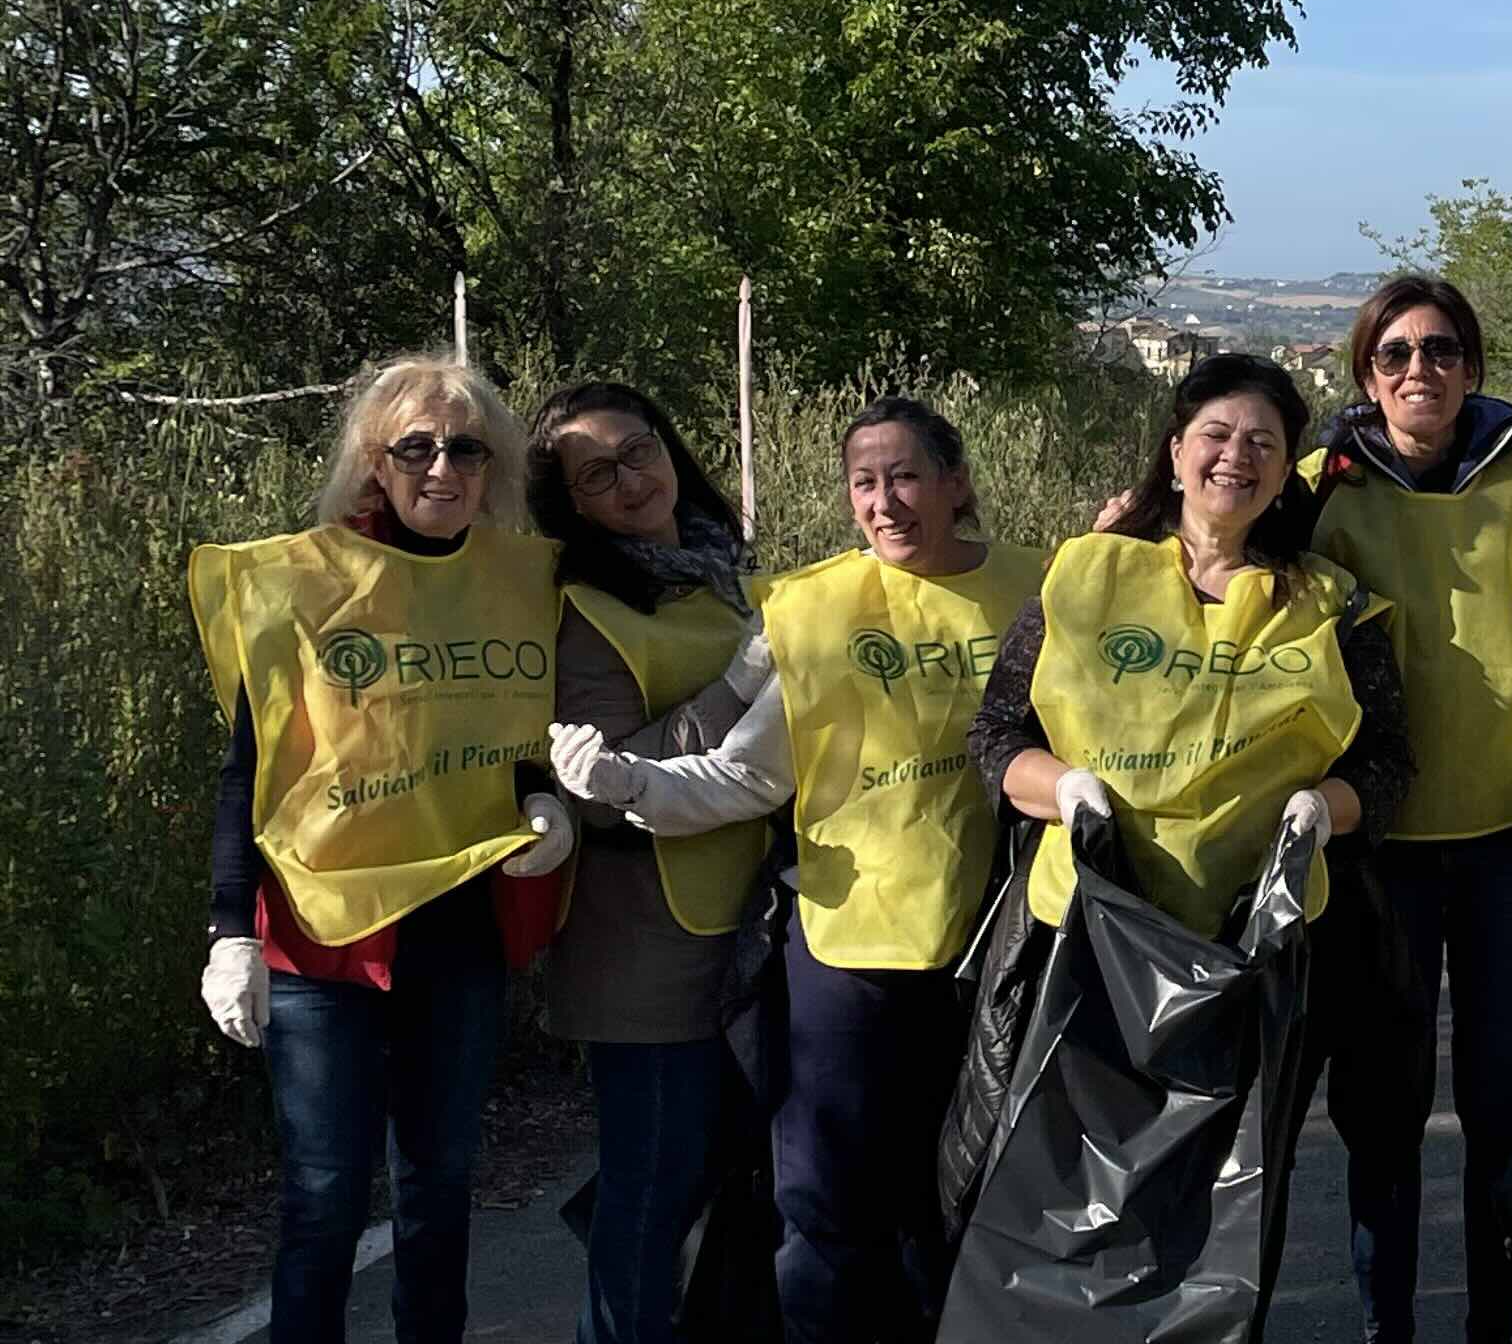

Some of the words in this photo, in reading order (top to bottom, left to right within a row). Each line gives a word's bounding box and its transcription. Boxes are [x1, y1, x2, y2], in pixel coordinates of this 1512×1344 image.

[394, 639, 548, 684] RIECO
[914, 635, 998, 678] RIE
[1163, 640, 1312, 679] RECO
[861, 754, 967, 791] Salviamo
[1186, 739, 1203, 766] il
[327, 765, 426, 810] Salvia
[432, 748, 449, 776] il
